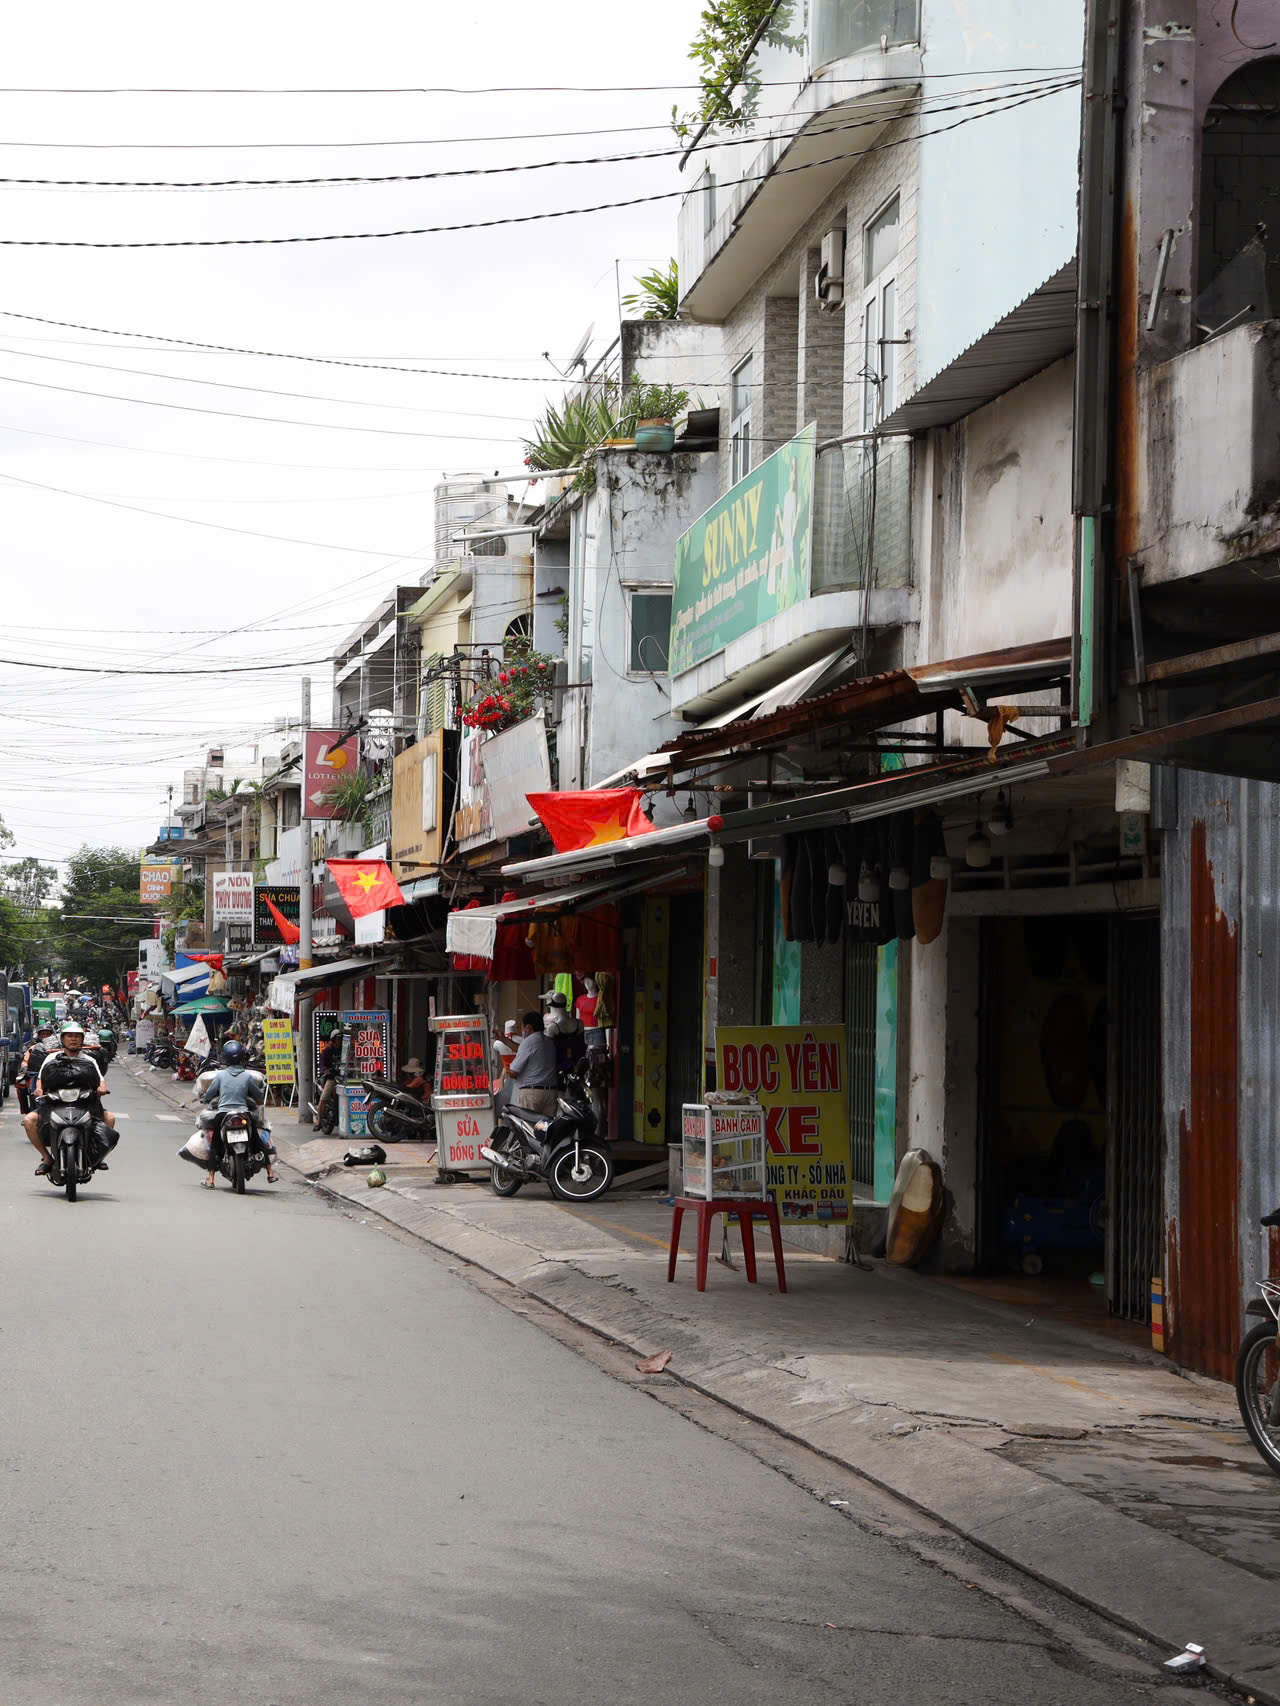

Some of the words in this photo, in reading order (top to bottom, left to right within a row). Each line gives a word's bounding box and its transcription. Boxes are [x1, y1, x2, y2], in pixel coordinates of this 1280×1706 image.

[702, 479, 764, 588] SUNNY
[308, 772, 352, 781] LOTTE
[228, 875, 250, 887] NÓN
[359, 1026, 380, 1042] SỬA
[784, 1031, 841, 1092] YÊN
[444, 1098, 485, 1107] SEIKO
[457, 1113, 480, 1136] SỬA
[715, 1115, 738, 1132] BÁNH
[740, 1117, 758, 1133] CAM
[449, 1140, 475, 1161] ĐỒNG
[787, 1165, 799, 1185] TY
[808, 1158, 822, 1185] SỐ
[825, 1160, 846, 1185] NHÀ
